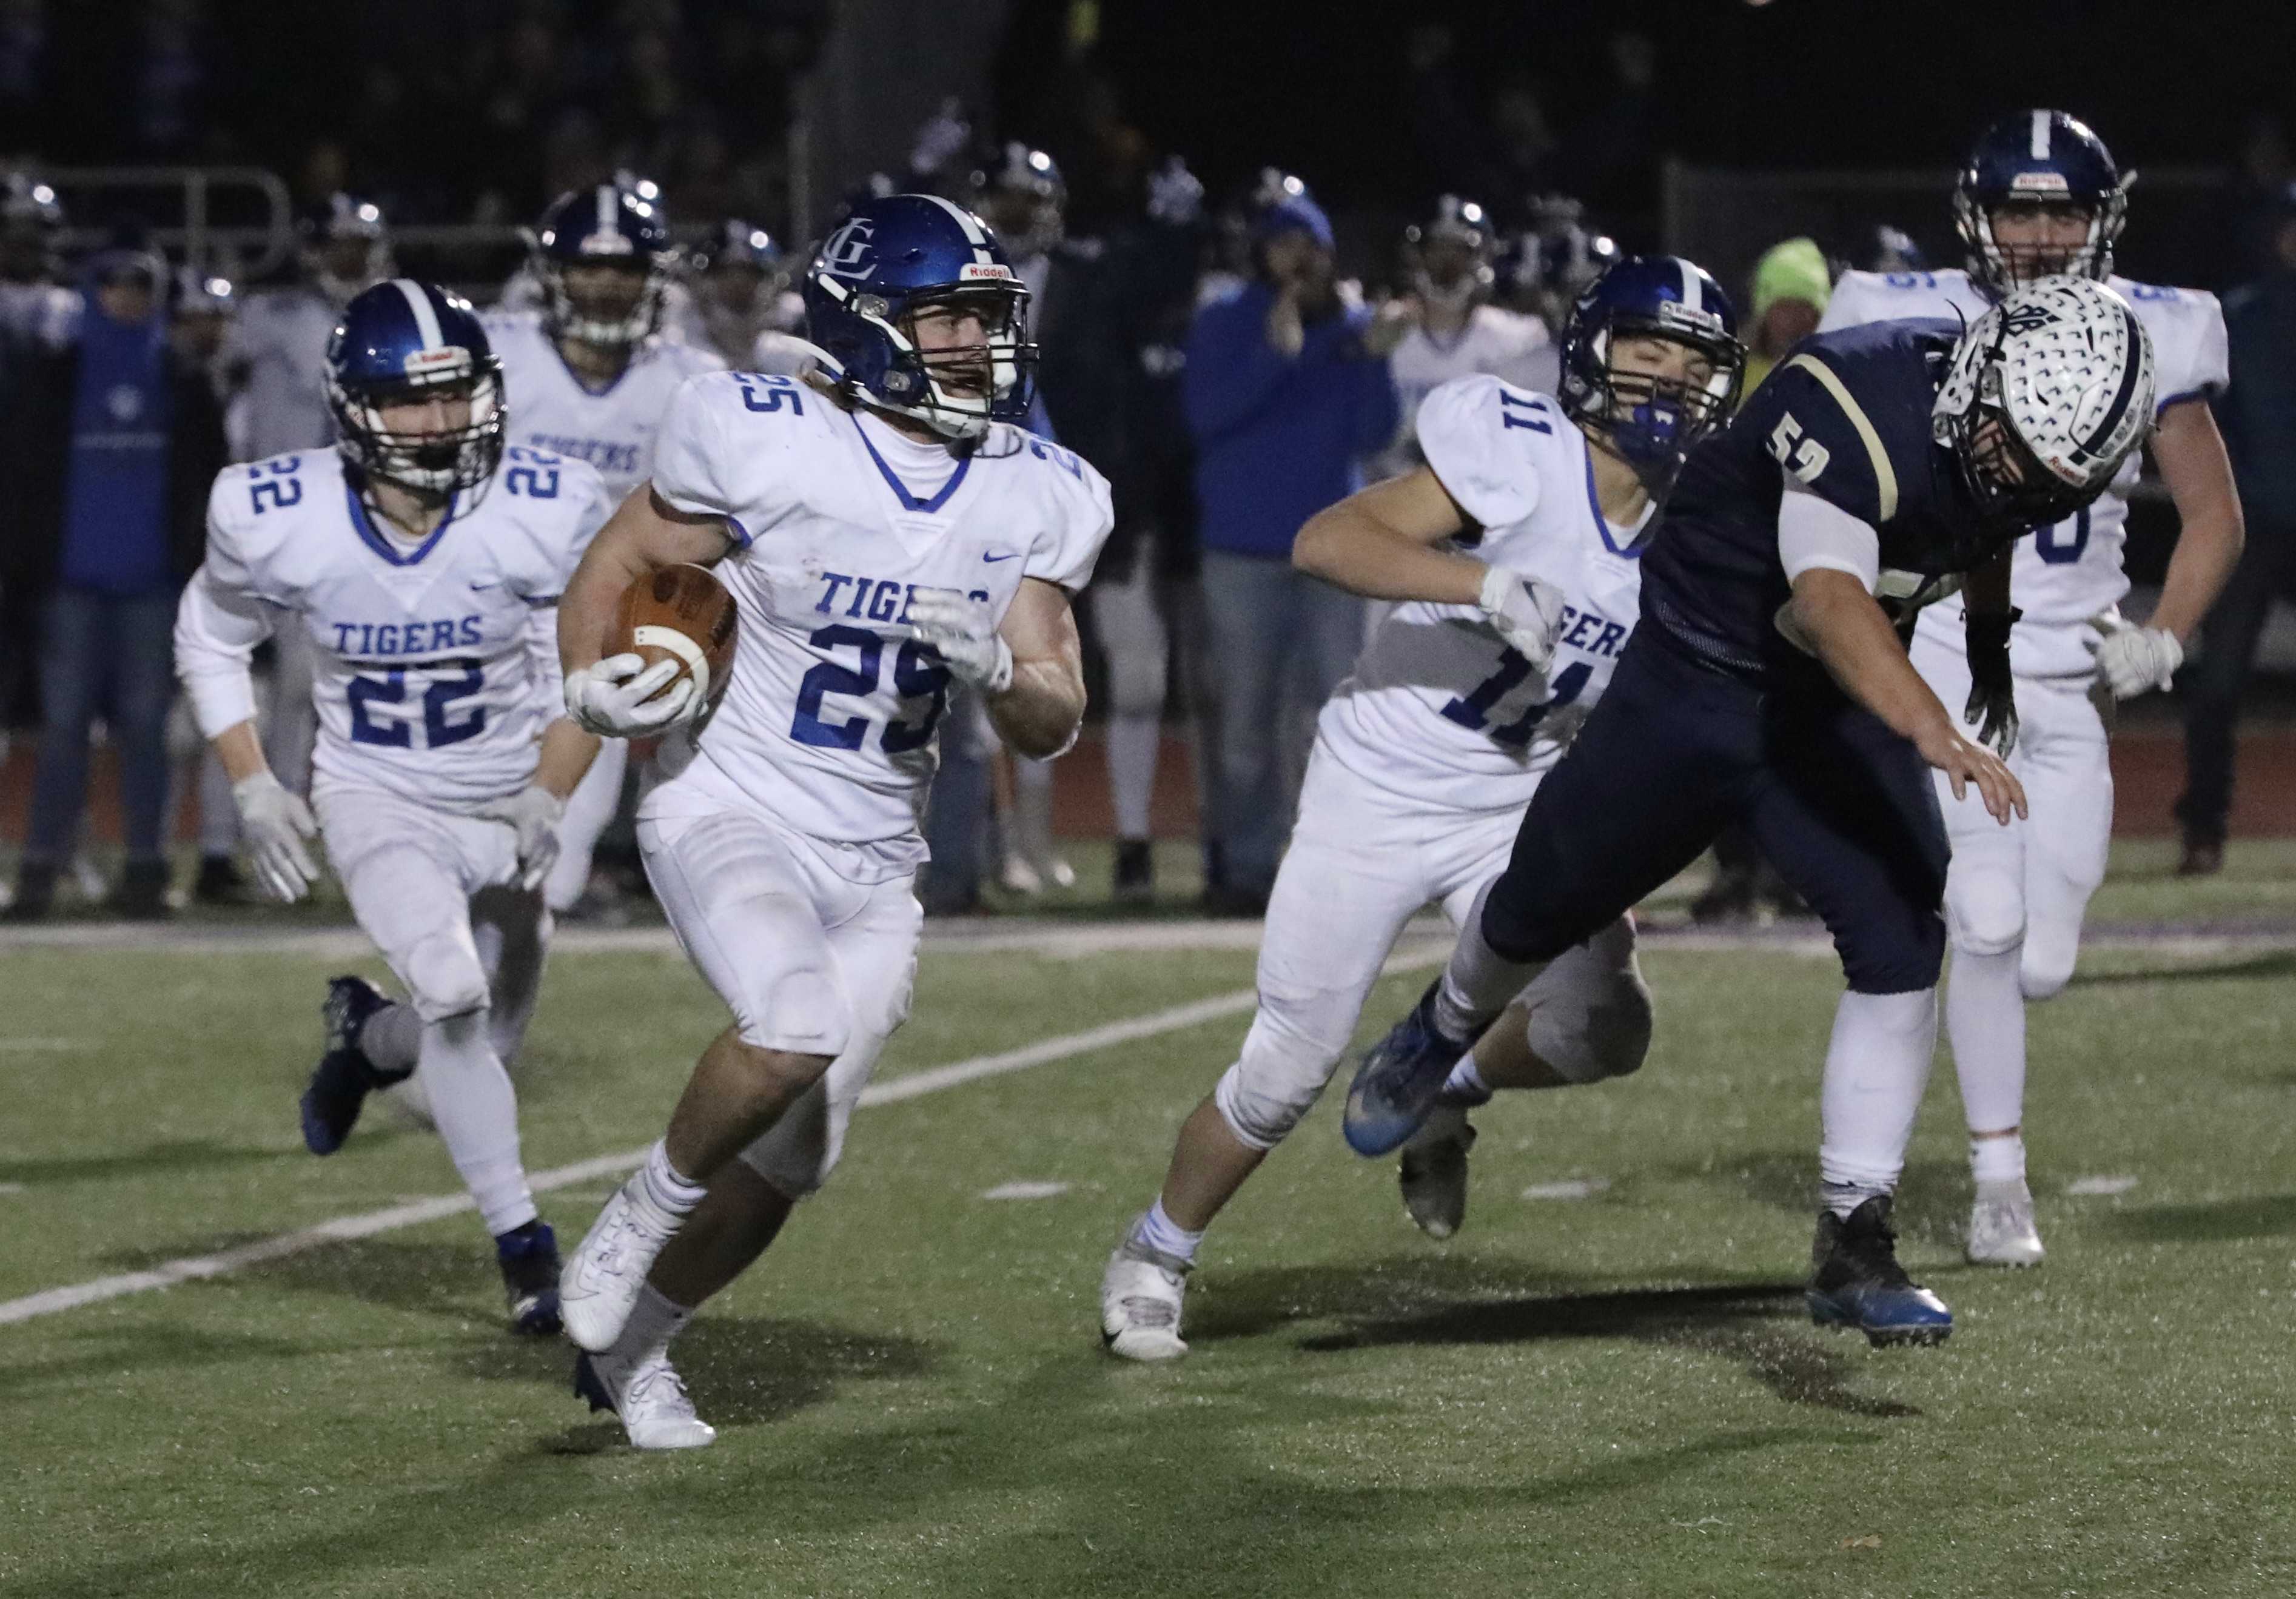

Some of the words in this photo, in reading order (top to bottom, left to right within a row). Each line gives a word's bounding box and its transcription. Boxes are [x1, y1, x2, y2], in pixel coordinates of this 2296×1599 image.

[1499, 388, 1553, 435] 11
[814, 572, 990, 625] TIG
[333, 615, 482, 655] TIGERS
[347, 657, 486, 749] 22
[1439, 645, 1595, 746] 11
